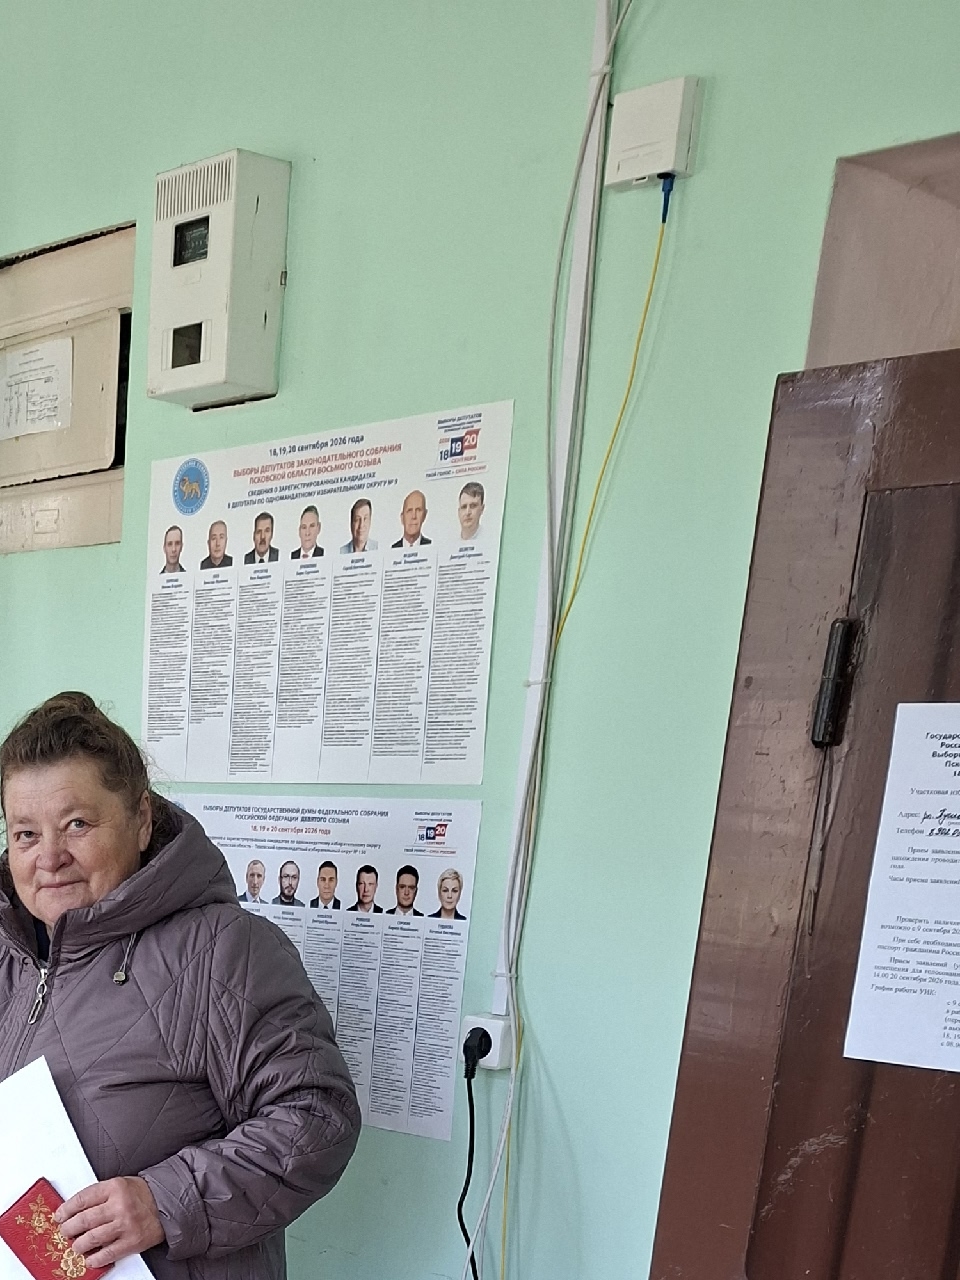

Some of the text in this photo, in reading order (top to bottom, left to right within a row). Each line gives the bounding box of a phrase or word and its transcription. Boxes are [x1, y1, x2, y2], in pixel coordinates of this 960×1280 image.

[298, 440, 328, 452] сентября
[330, 436, 346, 447] 2026
[348, 435, 364, 444] года
[464, 434, 476, 445] 20
[452, 442, 462, 454] 19
[233, 444, 401, 477] ВЫБОРЫ ДЕПУТАТОВ ЗАКОНОДАТЕЛЬНОГО СОБРАНИЯ
[440, 449, 449, 460] 18
[250, 458, 381, 484] ПСКОВСКОЙ ОБЛАСТИ ВОСЬМОГО СОЗЫВА
[436, 826, 445, 834] 20
